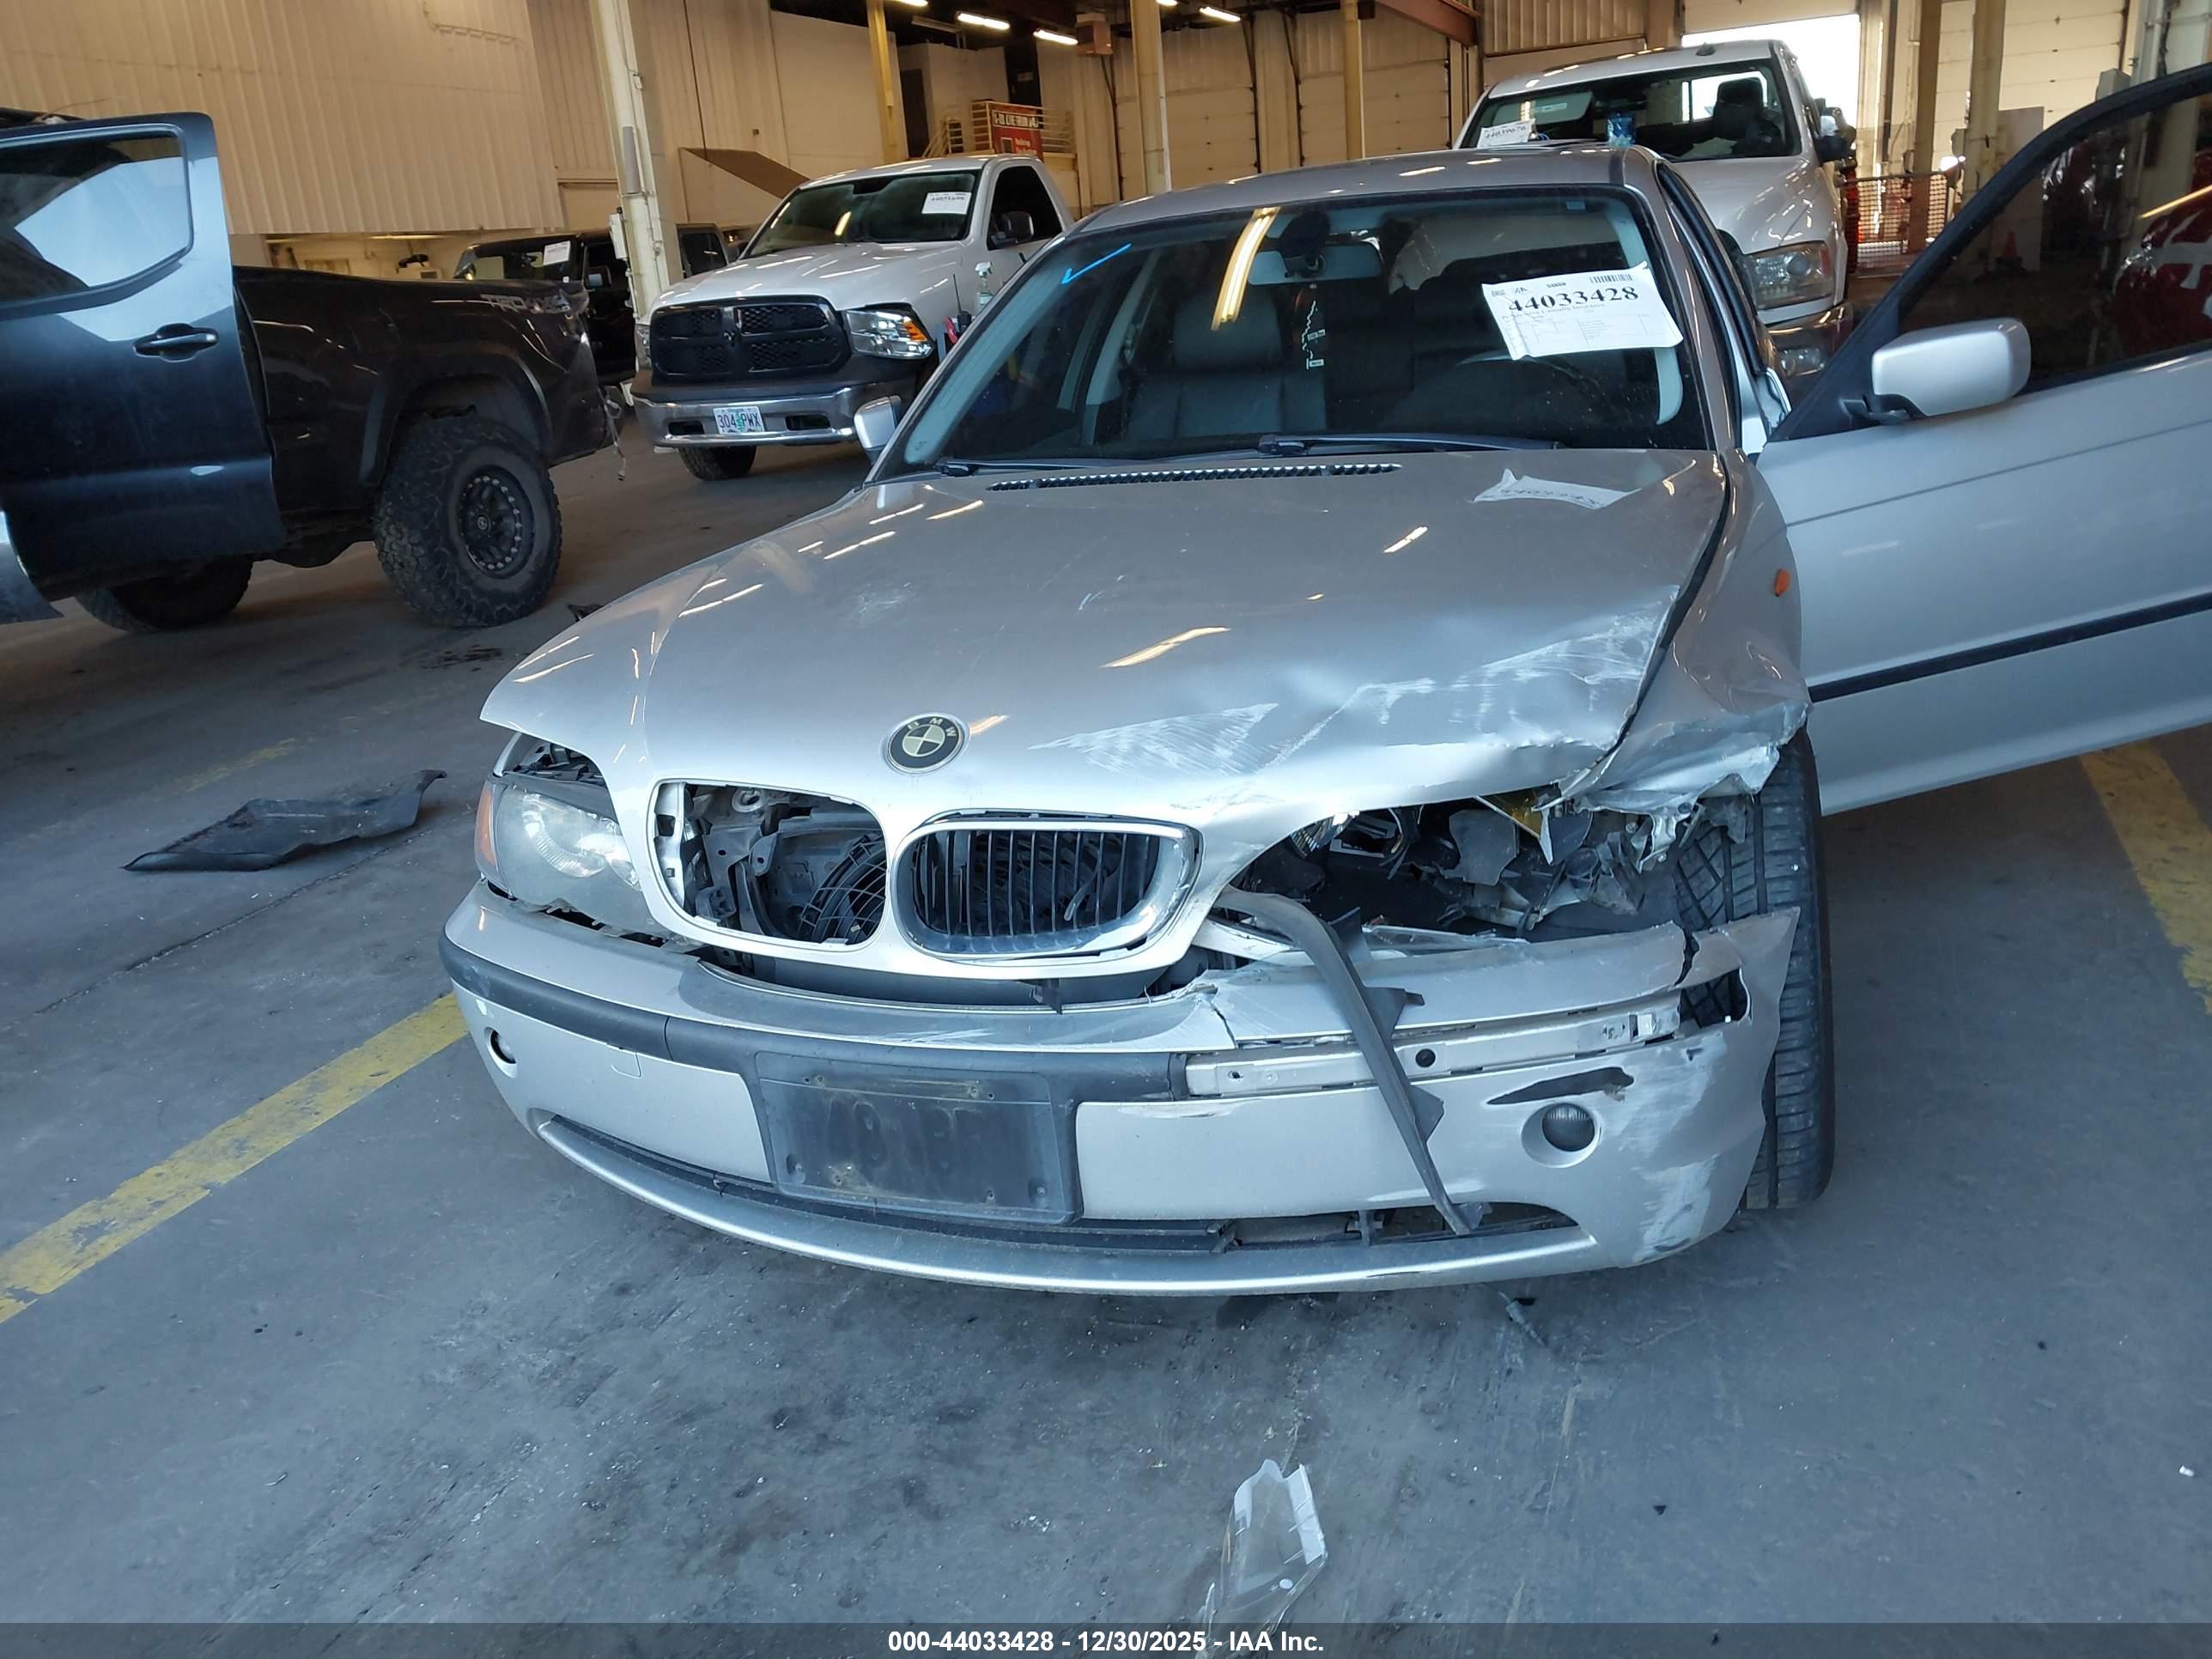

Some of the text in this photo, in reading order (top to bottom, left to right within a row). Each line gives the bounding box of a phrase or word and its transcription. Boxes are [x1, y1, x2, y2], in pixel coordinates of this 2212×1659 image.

[1509, 286, 1639, 312] 44033428
[717, 413, 737, 428] 304
[907, 717, 957, 738] BMW
